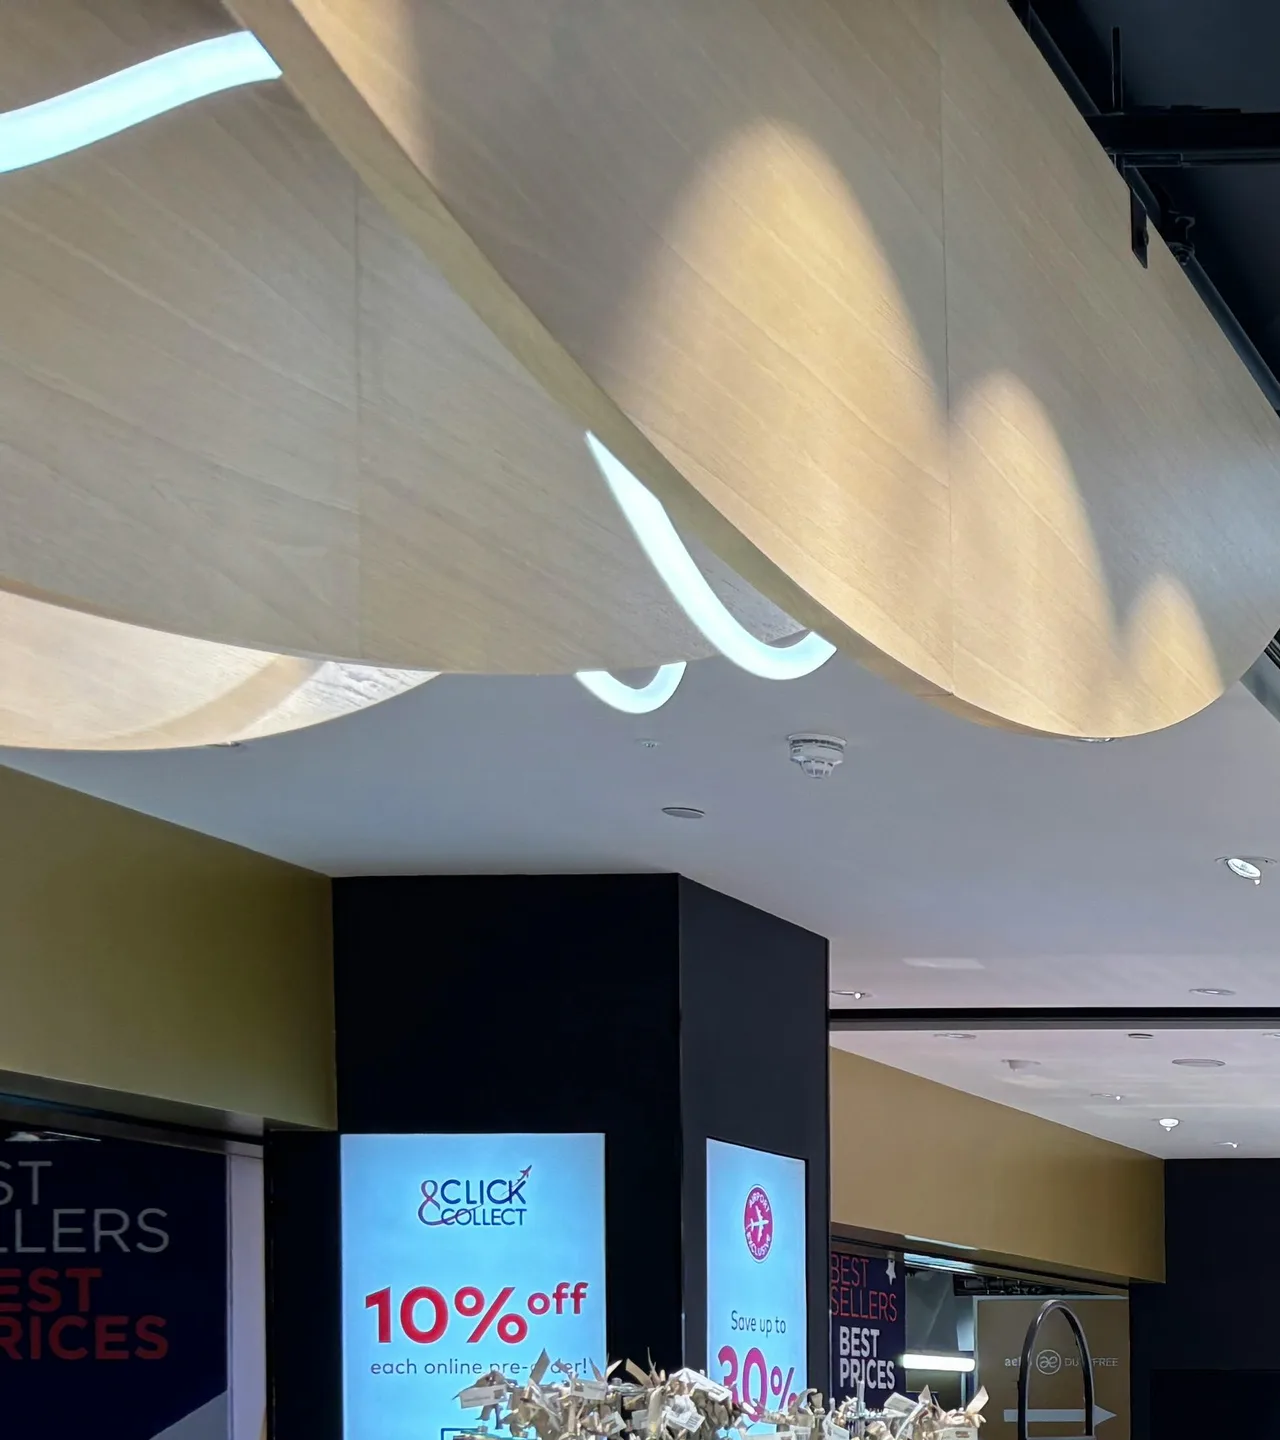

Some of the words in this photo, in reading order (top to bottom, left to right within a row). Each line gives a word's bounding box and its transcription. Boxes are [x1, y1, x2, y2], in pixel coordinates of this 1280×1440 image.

[440, 1178, 526, 1205] CLICK
[441, 1208, 527, 1226] COLLECT
[830, 1251, 869, 1287] BEST
[0, 1267, 103, 1313] EST
[830, 1284, 898, 1322] SELLERS
[365, 1285, 528, 1344] 10%
[527, 1281, 589, 1315] off
[730, 1310, 757, 1331] Save
[759, 1315, 773, 1339] up
[775, 1317, 787, 1335] to
[0, 1315, 169, 1361] RICES
[838, 1324, 880, 1358] BEST
[370, 1358, 417, 1374] each
[424, 1358, 483, 1374] online
[839, 1357, 897, 1390] PRICES
